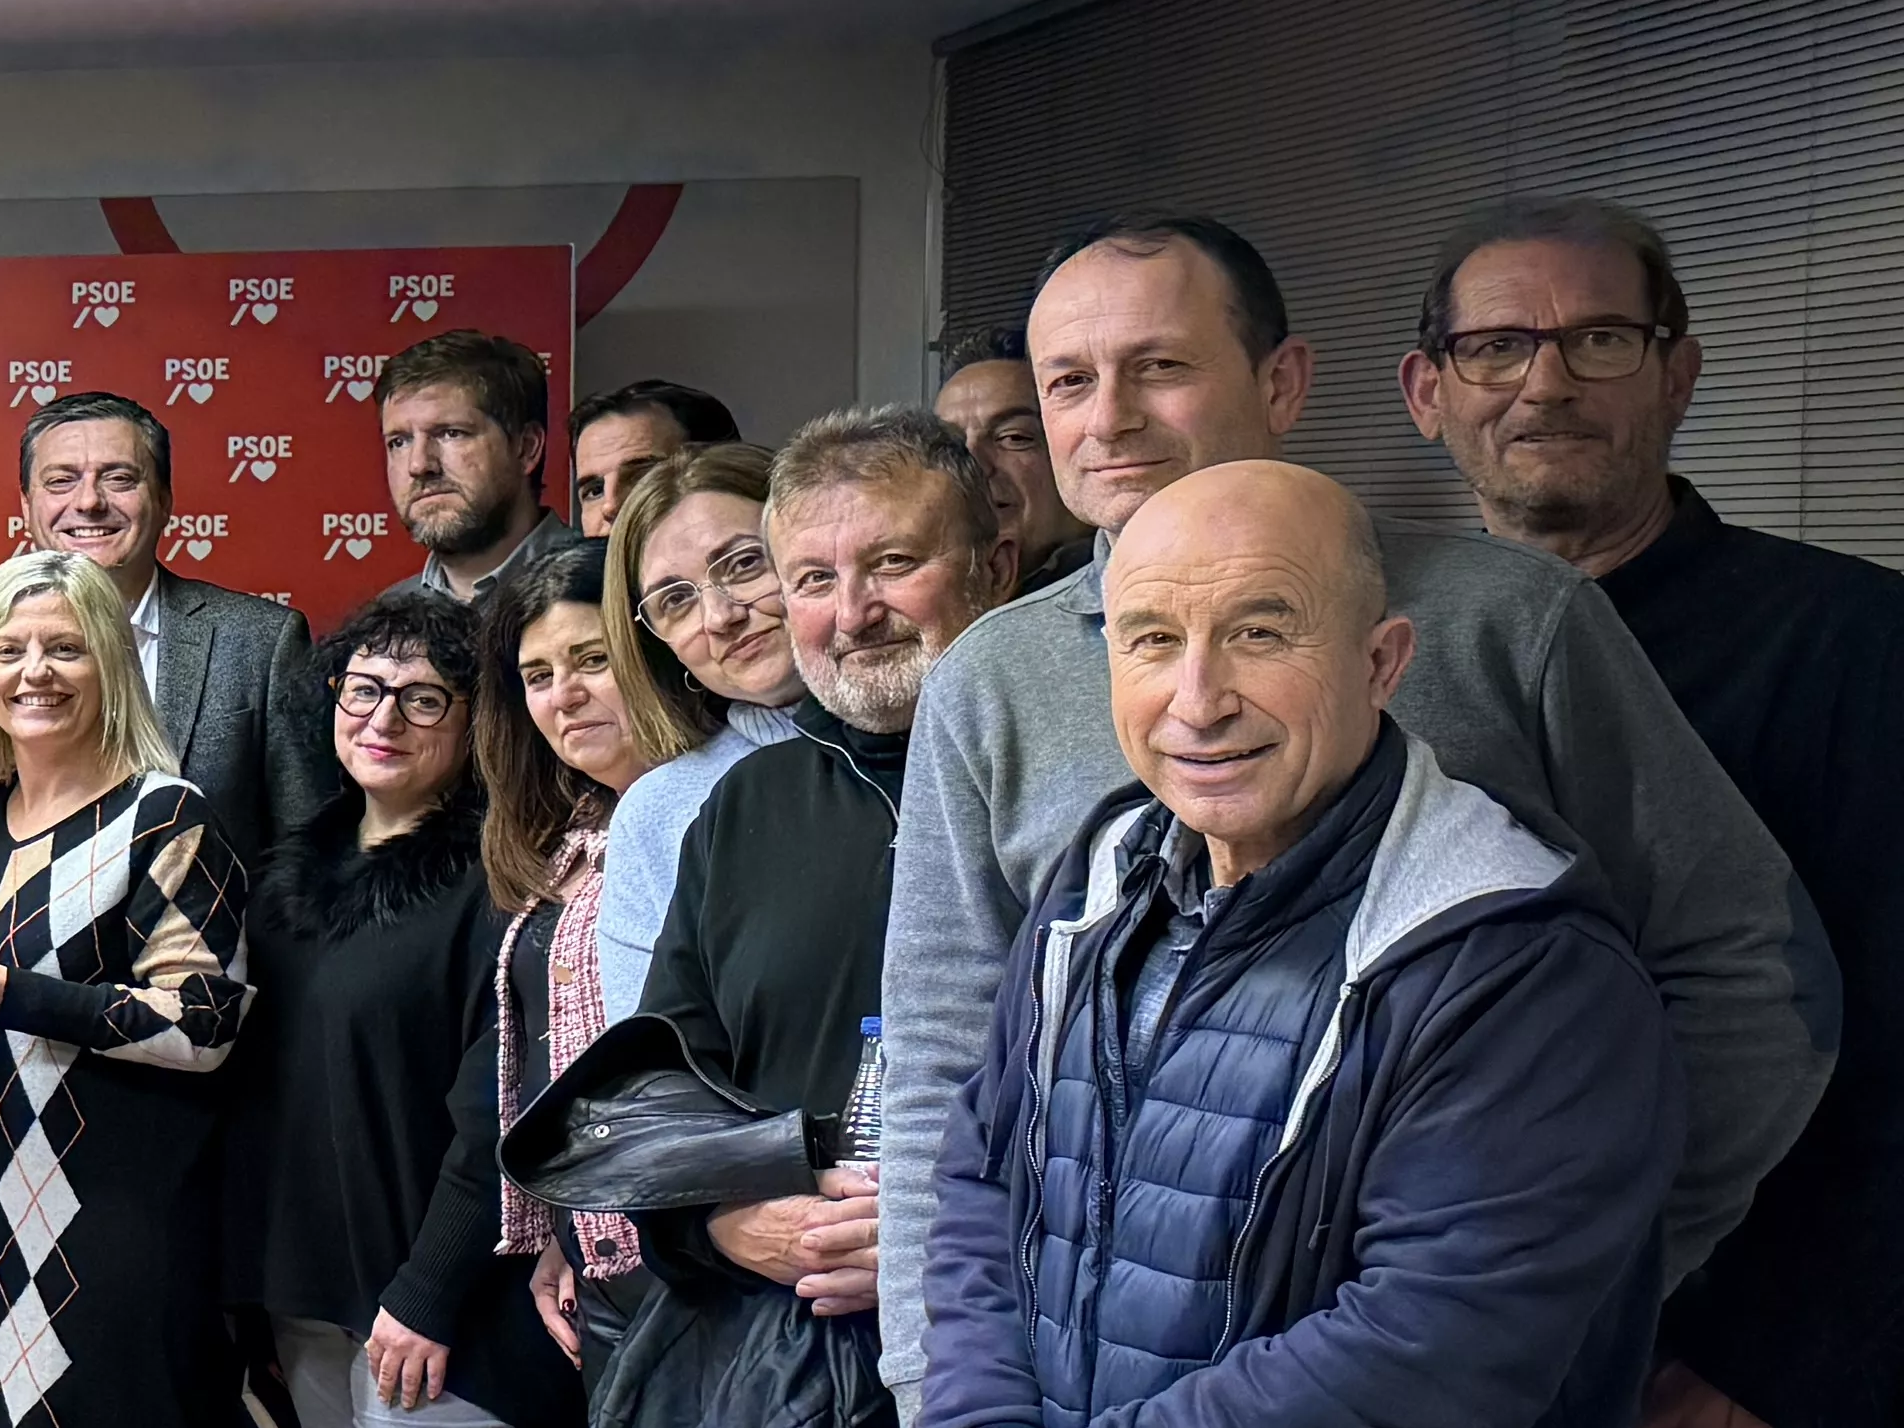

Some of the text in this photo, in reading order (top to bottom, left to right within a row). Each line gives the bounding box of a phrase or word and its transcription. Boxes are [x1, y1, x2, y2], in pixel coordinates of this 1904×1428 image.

[71, 281, 136, 305] PSOE
[229, 277, 294, 302] PSOE
[389, 274, 455, 298] PSOE
[9, 360, 73, 384] PSOE
[165, 357, 230, 382] PSOE
[227, 435, 293, 459] PSOE
[163, 514, 229, 538] PSOE
[323, 512, 389, 537] PSOE
